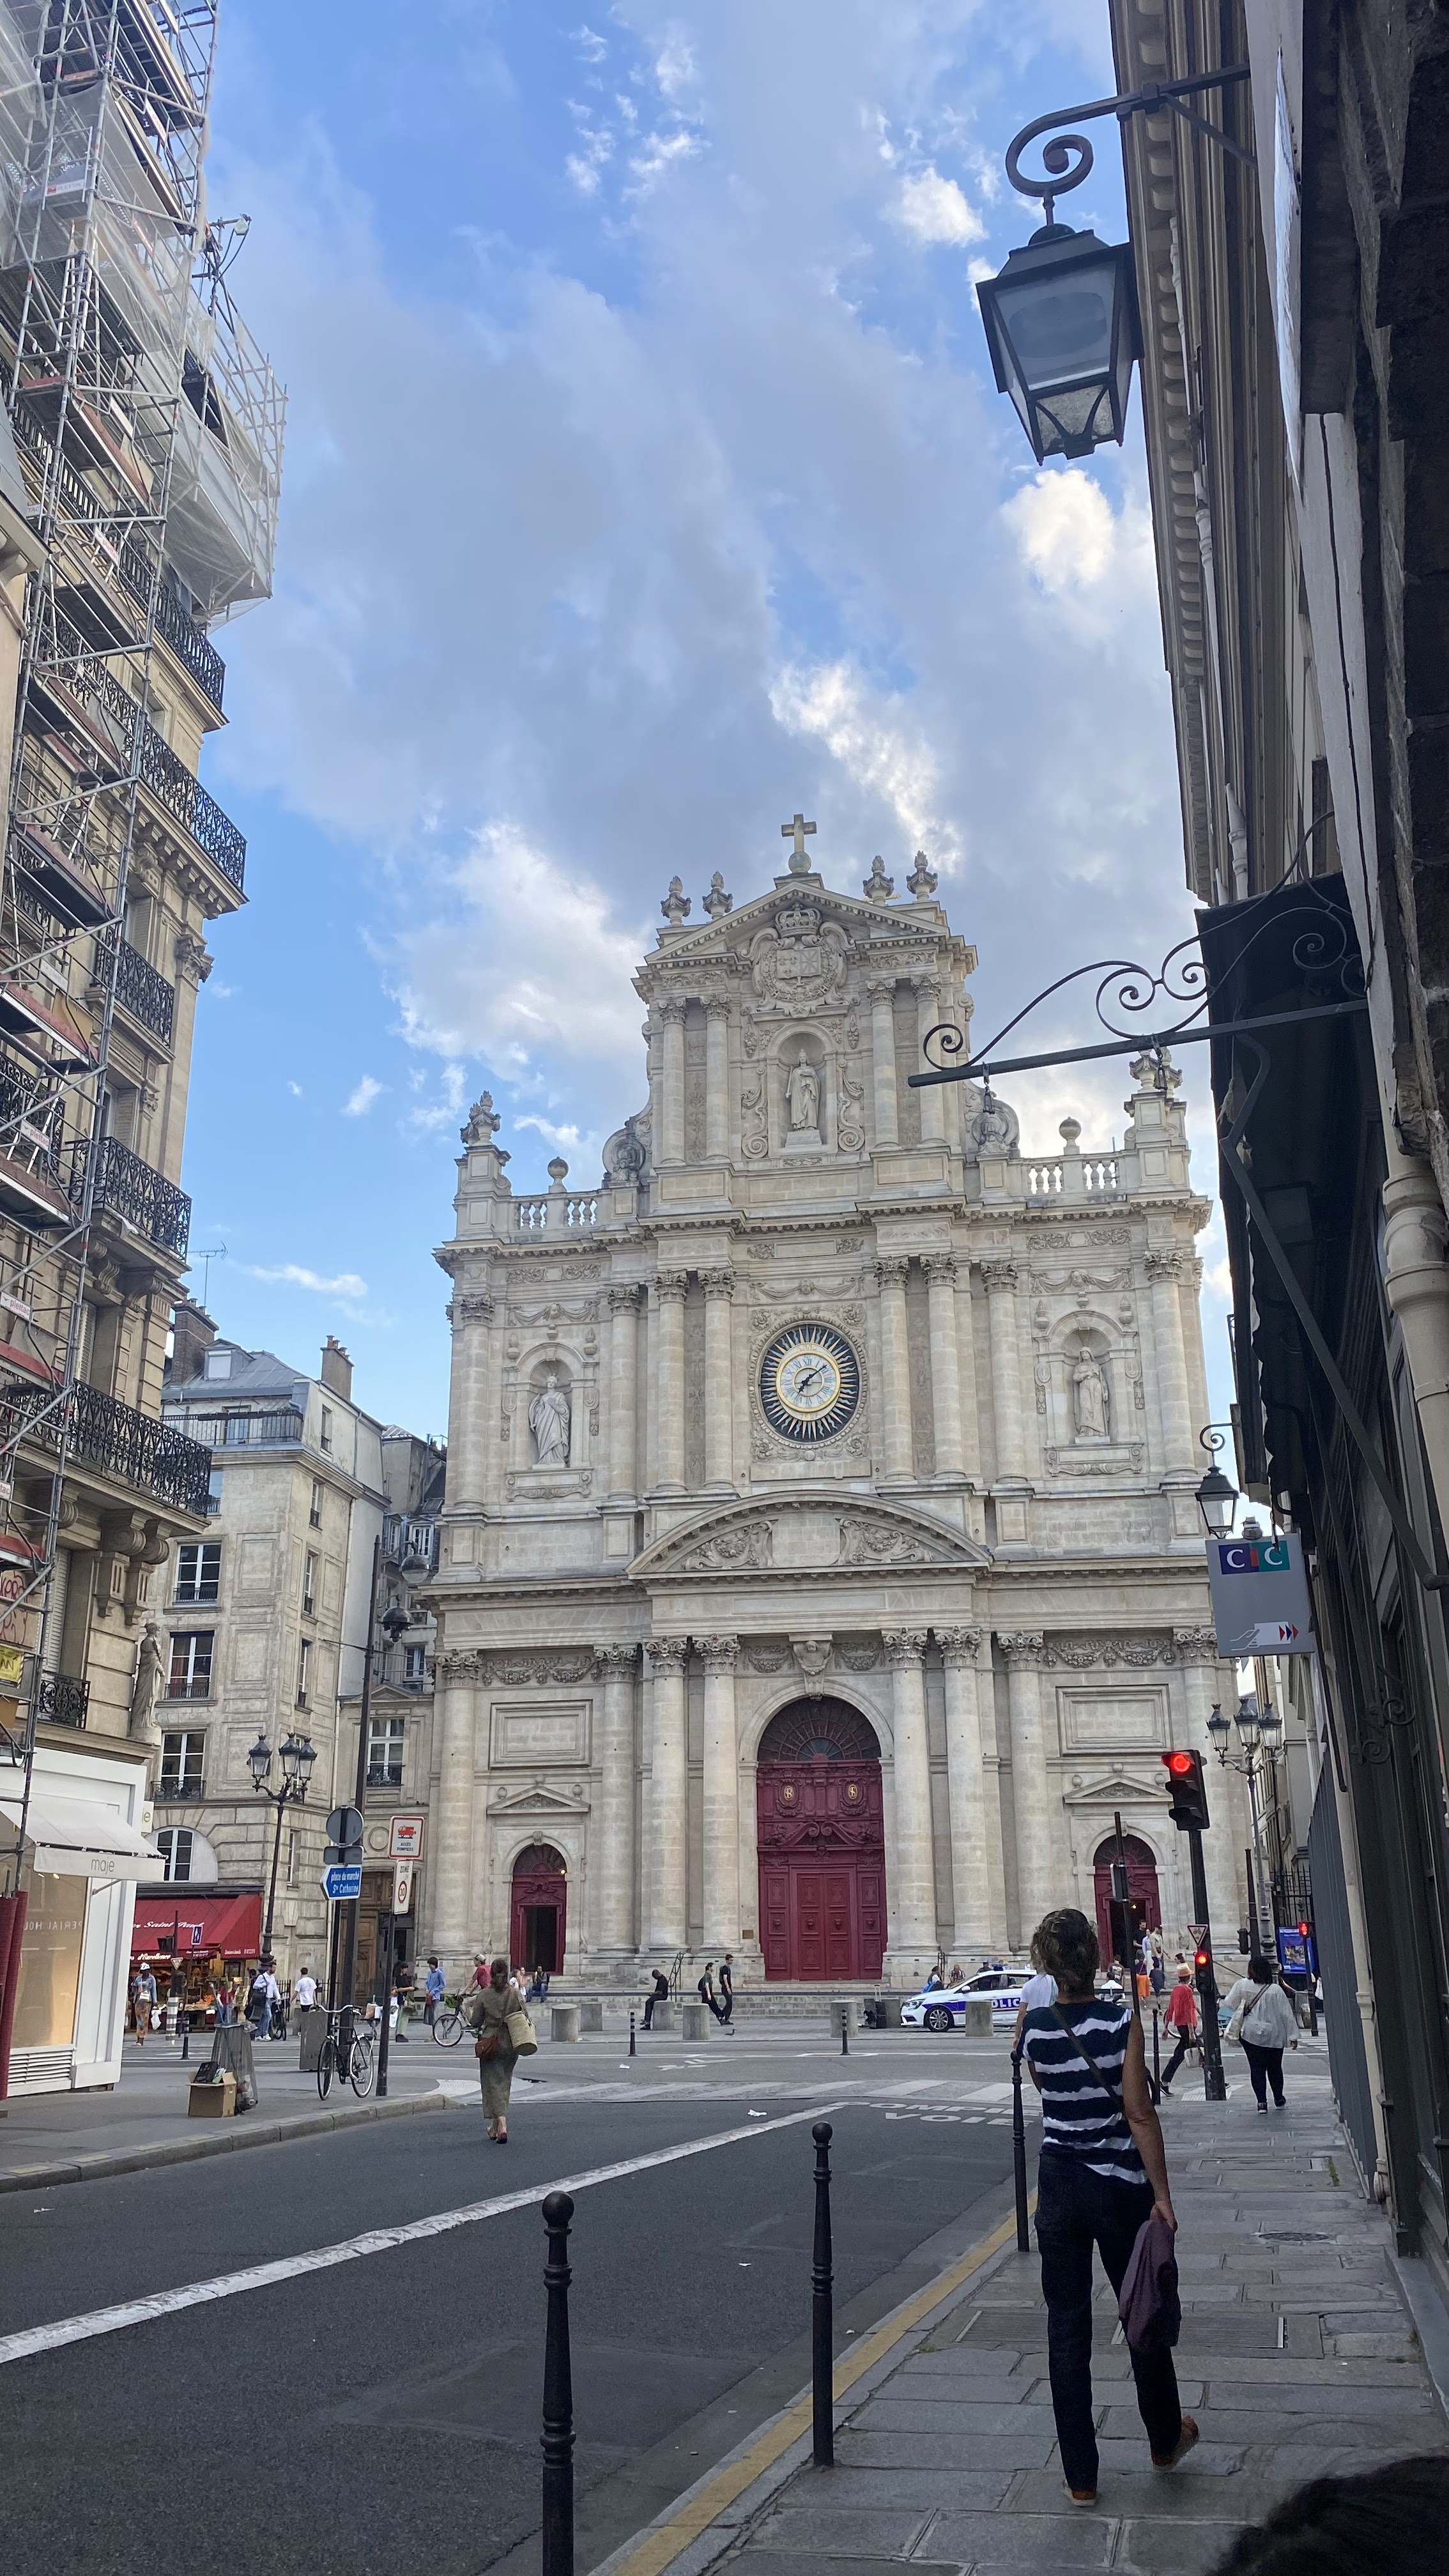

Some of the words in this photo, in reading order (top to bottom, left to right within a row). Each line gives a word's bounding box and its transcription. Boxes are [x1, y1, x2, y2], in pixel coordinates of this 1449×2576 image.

[30, 1129, 49, 1147] plettac
[10, 1300, 30, 1315] plettac
[0, 1483, 10, 1494] tac
[1227, 1546, 1283, 1568] CIC
[91, 1856, 114, 1874] maje
[399, 1865, 410, 1873] ZONE
[330, 1871, 341, 1884] place
[341, 1871, 346, 1881] du
[346, 1871, 360, 1881] marché
[339, 1883, 358, 1894] Catherine
[399, 1887, 406, 1897] 30
[992, 1998, 1020, 2008] OLIC
[827, 2101, 1043, 2117] POMPIE
[885, 2112, 1035, 2128] VOIE
